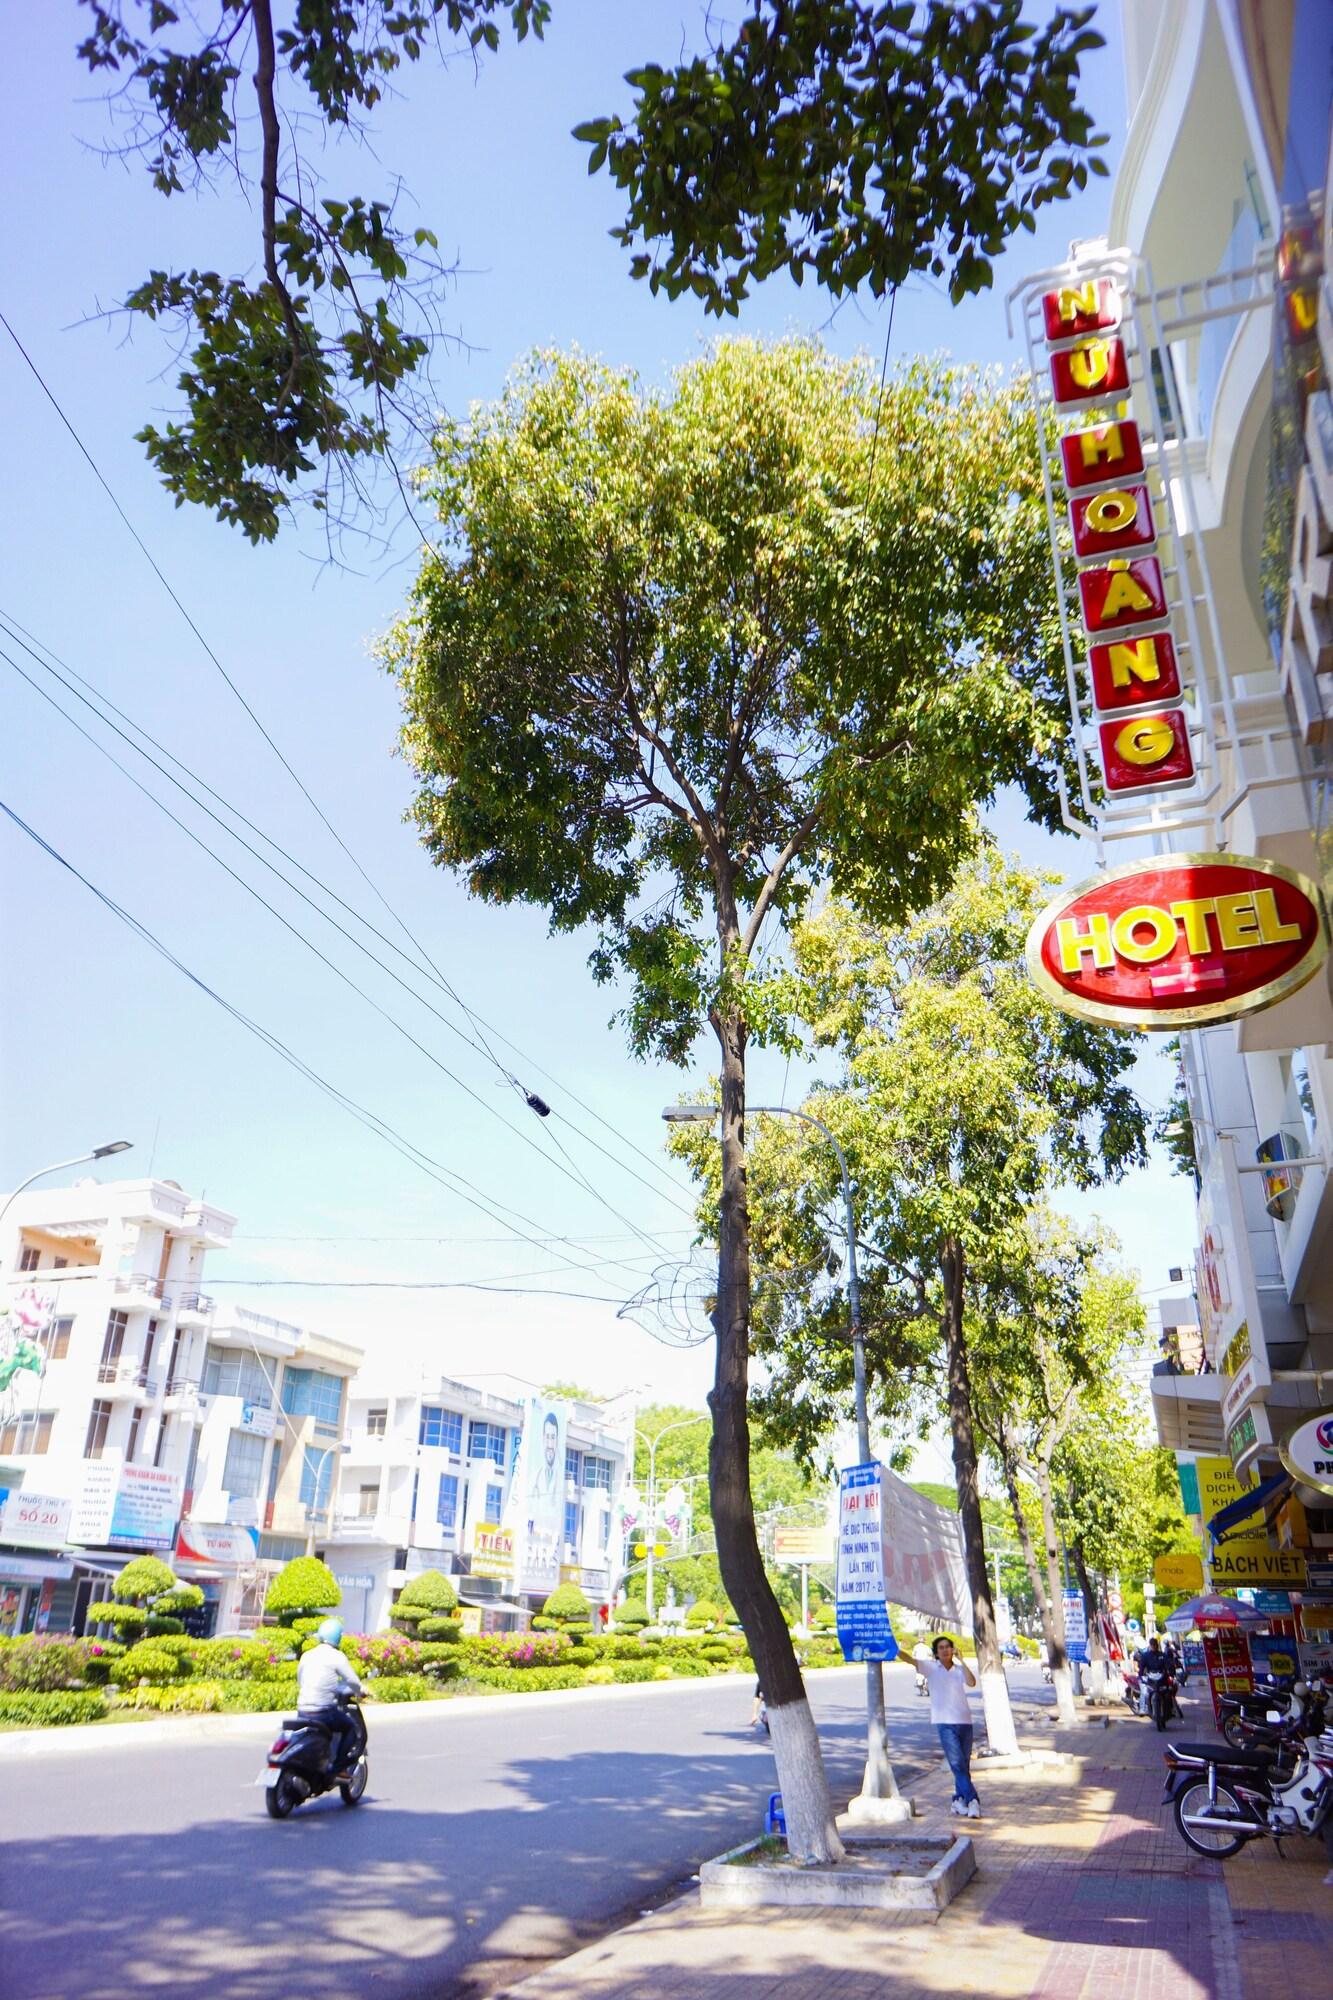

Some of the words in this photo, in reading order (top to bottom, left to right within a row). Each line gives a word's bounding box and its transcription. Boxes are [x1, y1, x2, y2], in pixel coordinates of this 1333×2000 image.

[1056, 888, 1302, 974] HOTEL
[1214, 1552, 1259, 1573] BÁCH
[1264, 1552, 1300, 1577] VIỆT
[855, 1581, 871, 1593] 2017
